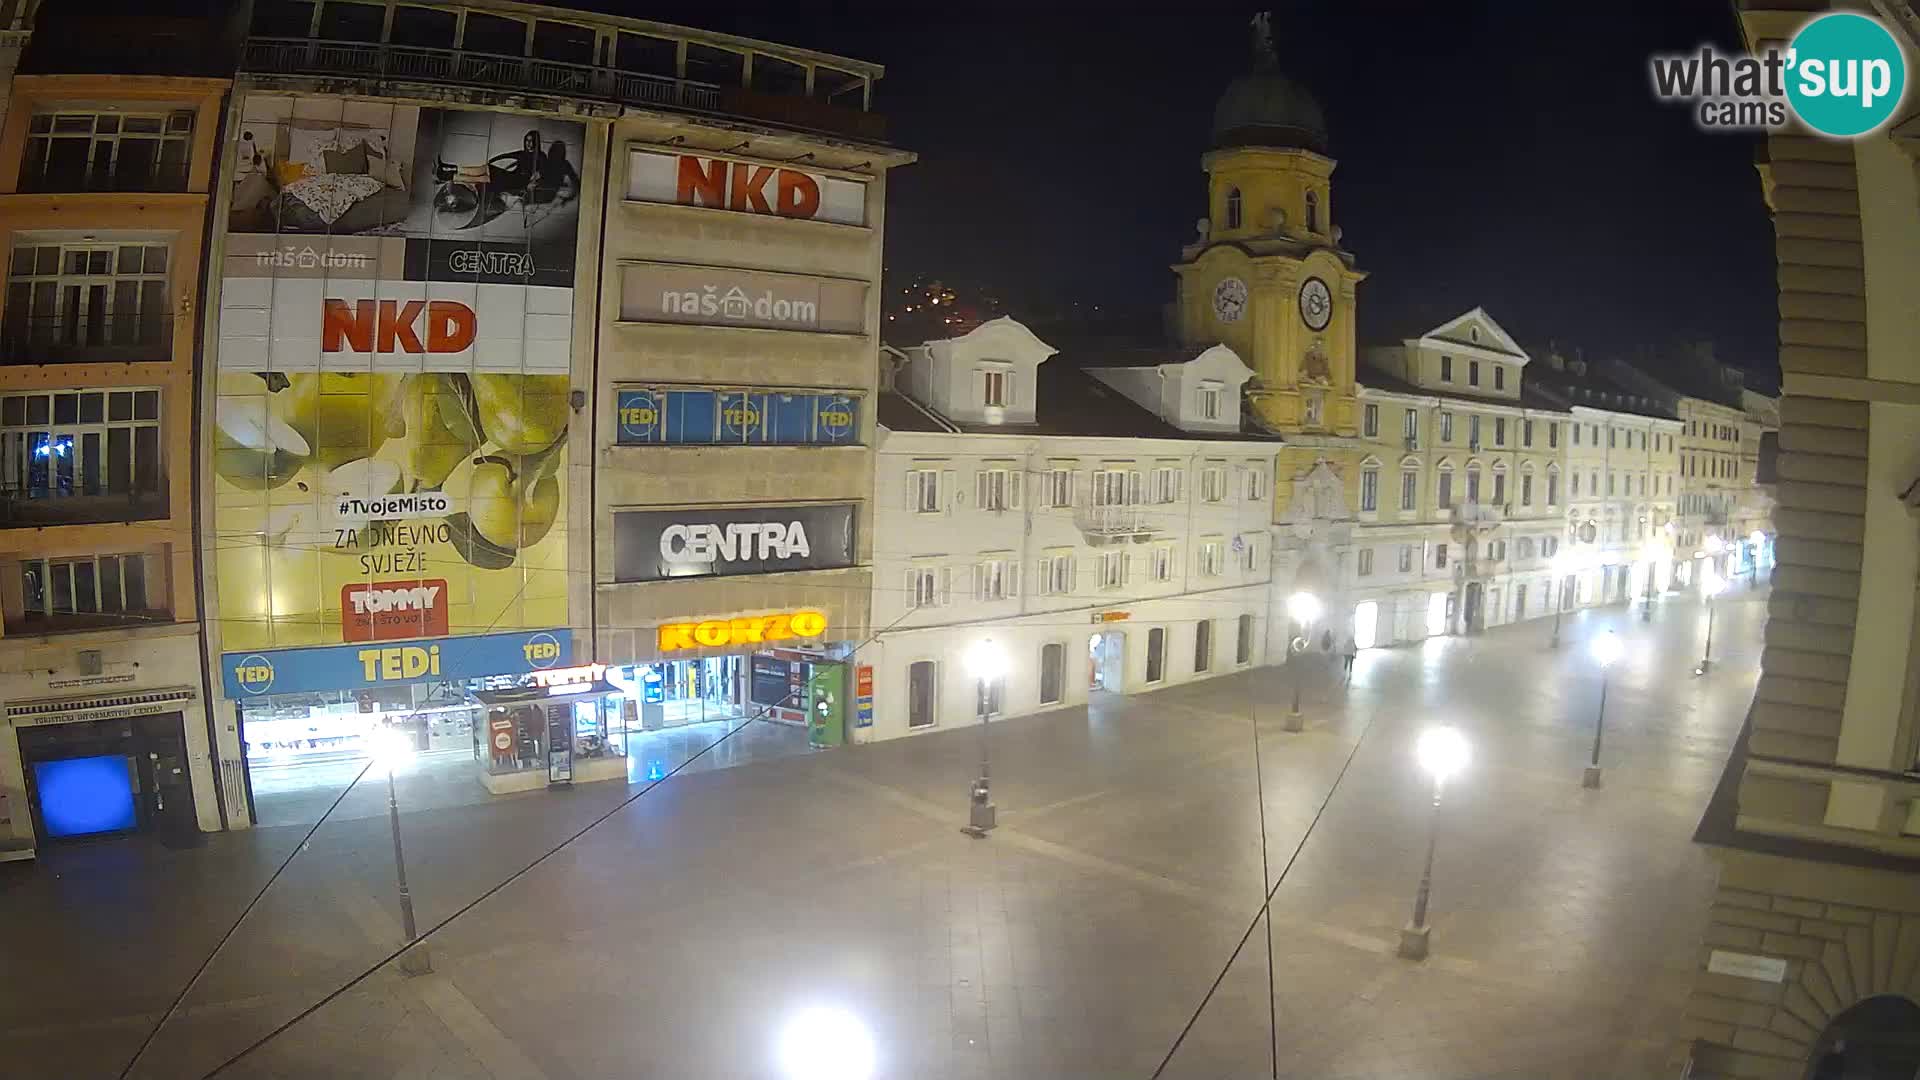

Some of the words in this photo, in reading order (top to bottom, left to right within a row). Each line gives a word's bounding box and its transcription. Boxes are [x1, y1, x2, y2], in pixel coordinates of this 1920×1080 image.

[676, 155, 820, 218] NKD
[256, 246, 296, 266] naš
[321, 247, 366, 268] dom
[448, 250, 536, 276] CENTRA
[661, 285, 719, 316] naš
[754, 289, 817, 322] dom
[322, 298, 478, 353] NKD
[339, 498, 447, 516] #TvojeMisto
[334, 528, 358, 549] ZA
[370, 523, 452, 547] DNEVNO
[659, 520, 810, 562] CENTRA
[361, 547, 428, 575] SVJEŽE
[350, 586, 440, 614] TOMMY
[358, 645, 441, 681] TEDi
[522, 641, 561, 660] TEDi
[235, 666, 275, 684] TEDi
